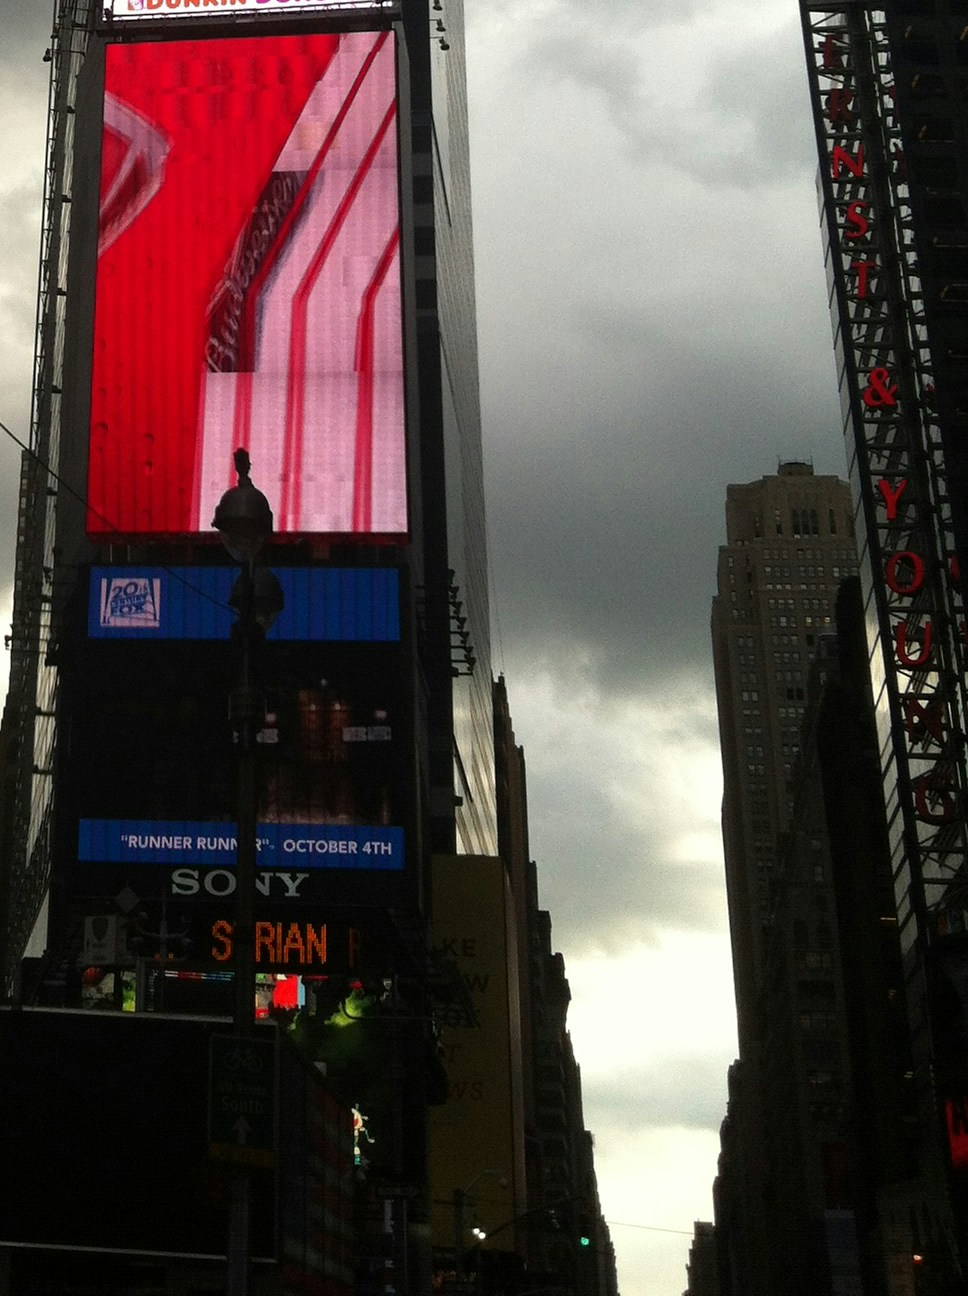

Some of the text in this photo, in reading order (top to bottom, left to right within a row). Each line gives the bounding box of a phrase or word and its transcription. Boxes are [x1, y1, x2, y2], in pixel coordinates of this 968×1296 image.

[861, 367, 898, 409] &
[877, 480, 952, 823] YOUNG
[282, 838, 358, 855] OCTOBER
[361, 841, 393, 856] 4TH
[171, 868, 309, 897] SONY
[211, 919, 328, 965] SRIAN
